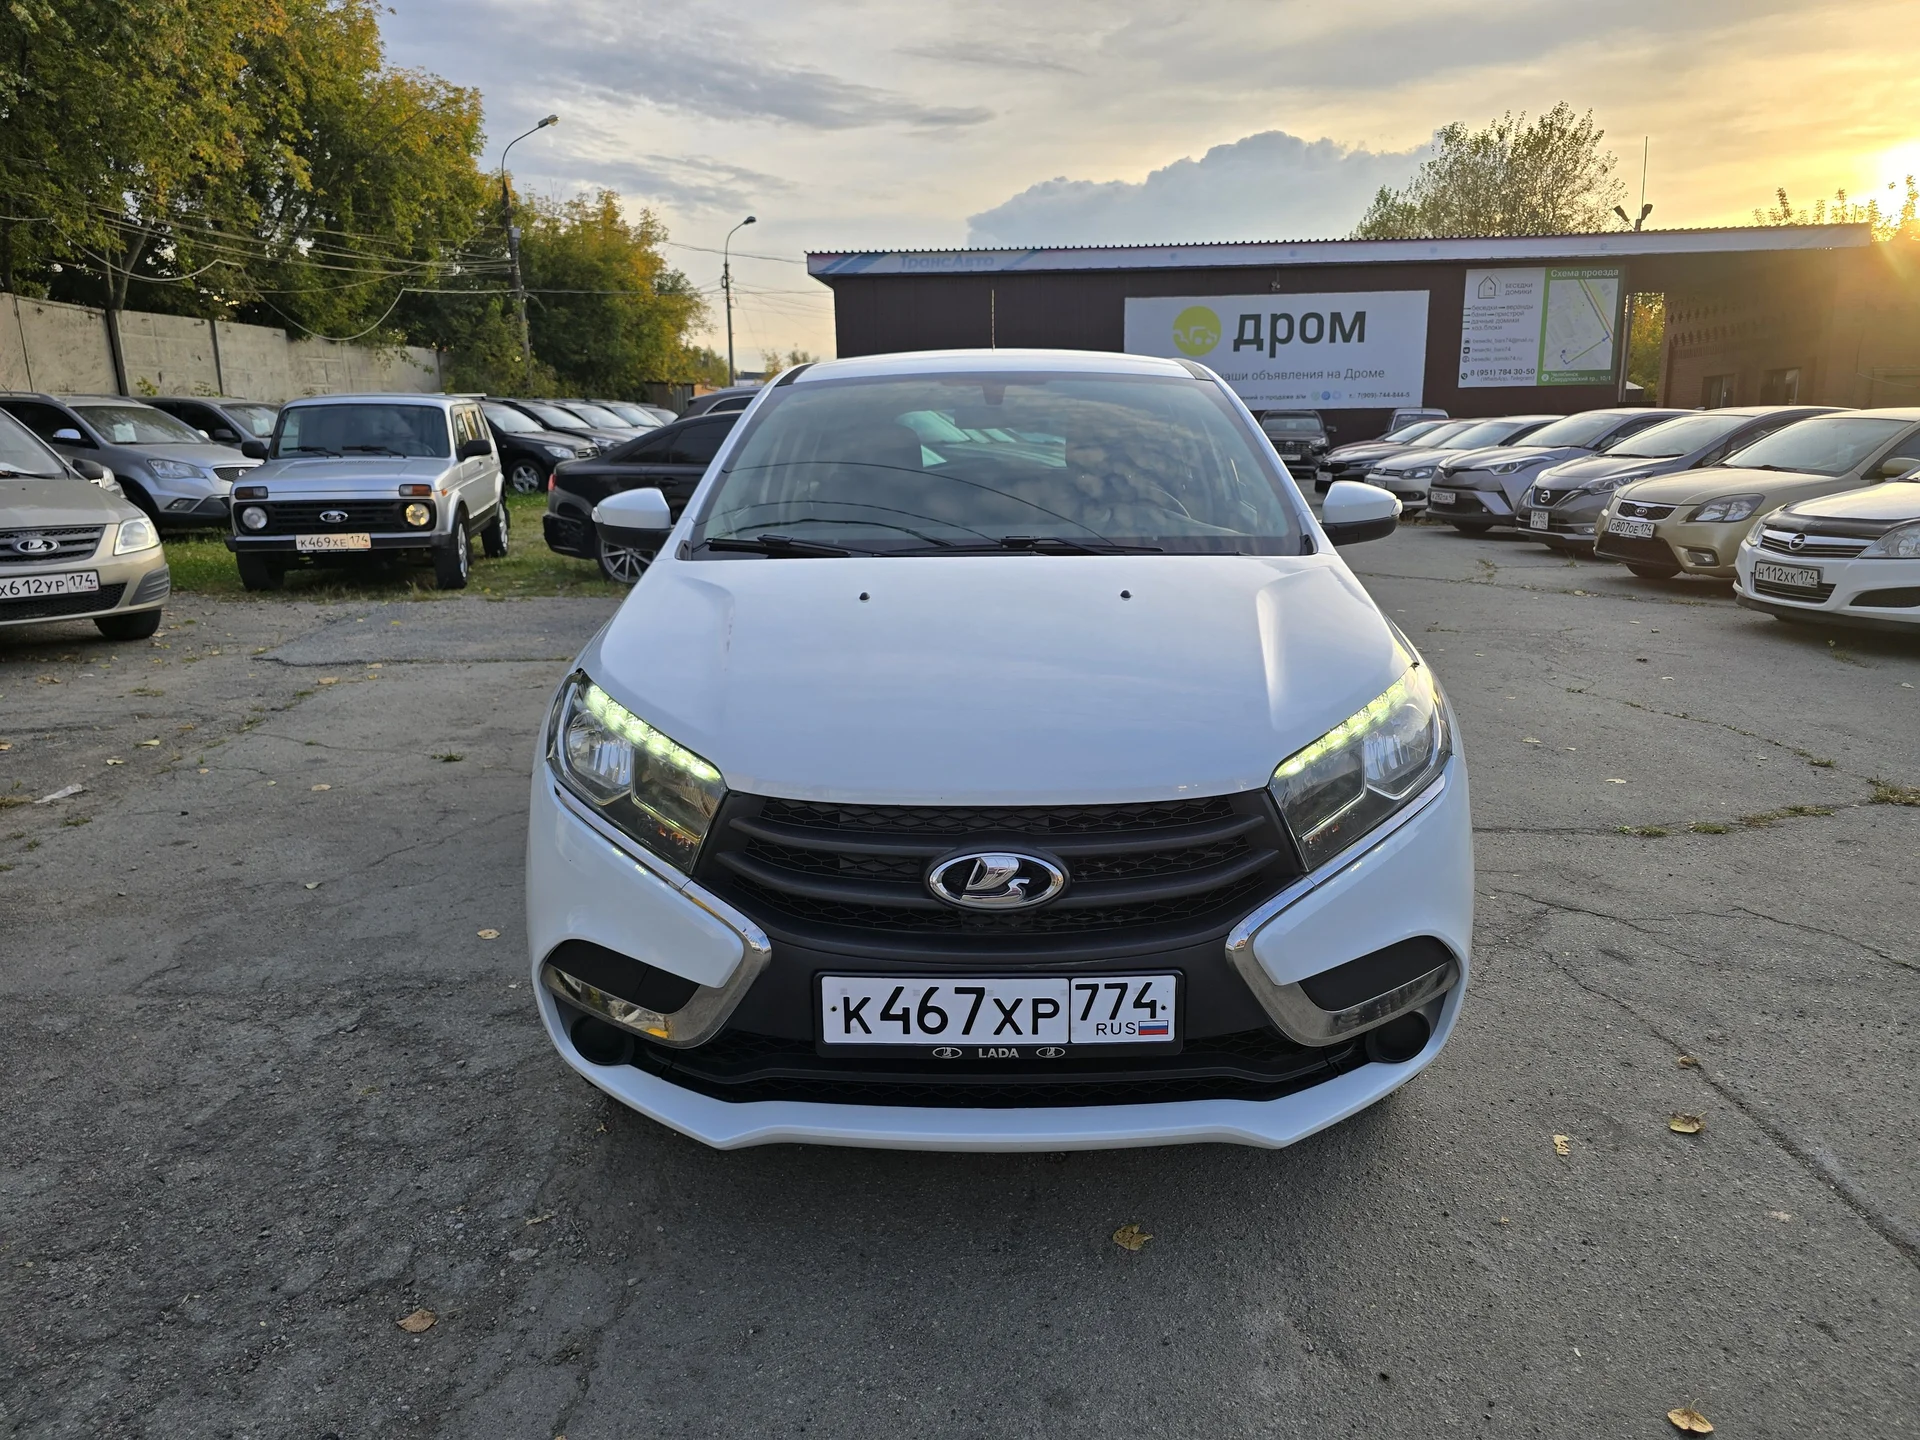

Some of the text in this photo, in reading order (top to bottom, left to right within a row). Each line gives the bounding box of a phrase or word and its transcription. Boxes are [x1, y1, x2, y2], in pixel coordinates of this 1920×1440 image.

[900, 254, 994, 269] ТрансАвто
[1581, 269, 1619, 277] проезда
[1233, 311, 1367, 359] дром
[1252, 370, 1323, 381] объявления
[1327, 371, 1341, 379] на
[1344, 369, 1385, 381] Дроме
[1477, 369, 1496, 377] (951)
[1611, 522, 1651, 534] О807ОЕ 174
[300, 535, 368, 548] К469ХЕ 174
[1758, 566, 1815, 584] Н112ХК 174
[0, 574, 94, 597] Х612УР 174
[843, 982, 1157, 1036] К467ХР 774
[1096, 1021, 1136, 1036] RUS
[978, 1048, 1019, 1059] LADA
